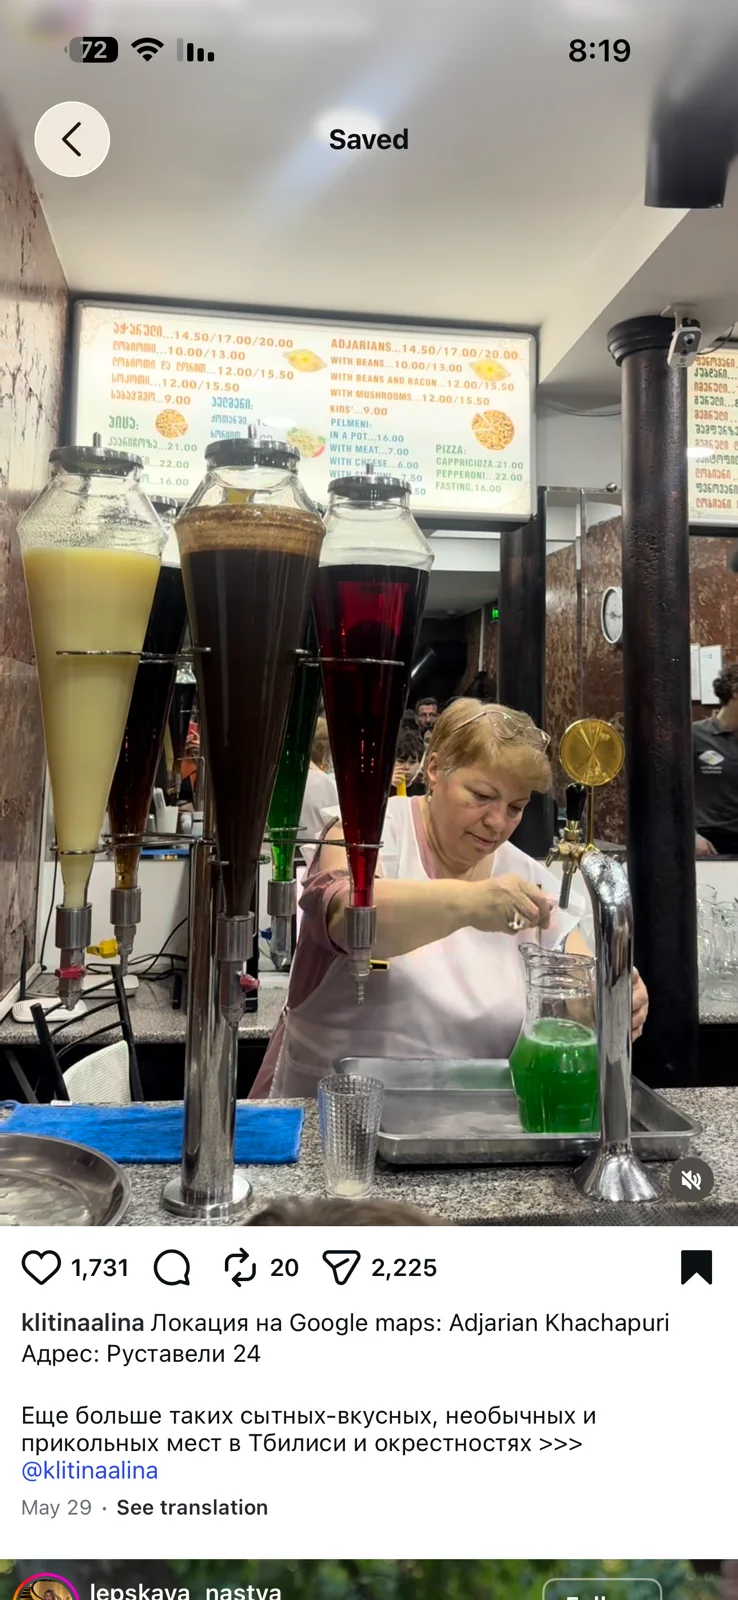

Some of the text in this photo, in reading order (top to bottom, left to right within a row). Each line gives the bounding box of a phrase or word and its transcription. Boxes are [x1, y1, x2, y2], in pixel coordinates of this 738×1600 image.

[330, 356, 353, 365] WITH
[330, 373, 353, 382] WITH
[356, 374, 384, 384] BEANS
[387, 375, 405, 385] AND
[330, 388, 353, 398] WITH
[331, 418, 372, 429] PELMENI:
[330, 431, 338, 440] IN
[342, 431, 348, 440] A
[329, 444, 352, 453] WITH
[436, 444, 467, 455] PIZZA:
[329, 457, 352, 466] WITH
[329, 470, 351, 479] WITH
